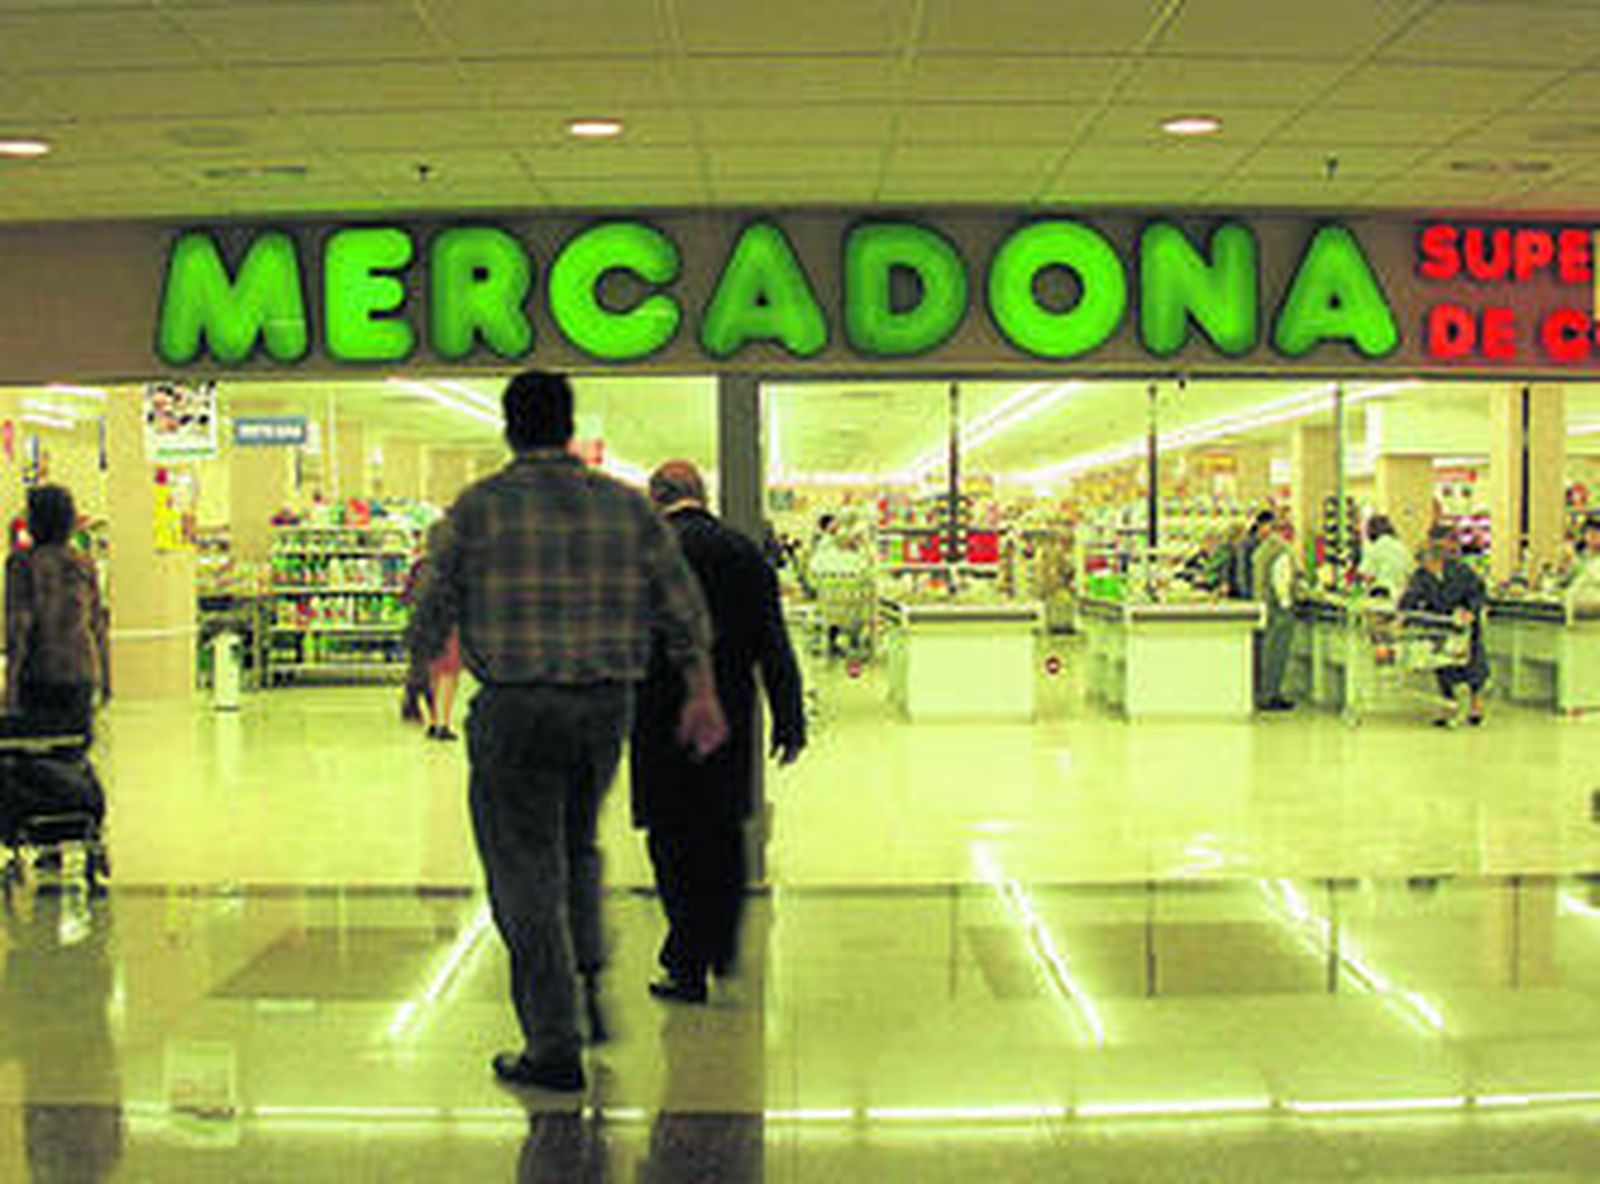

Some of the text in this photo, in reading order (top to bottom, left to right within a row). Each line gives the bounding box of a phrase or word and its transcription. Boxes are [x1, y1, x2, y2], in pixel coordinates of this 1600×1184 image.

[156, 220, 1399, 362] MERCADONA
[1428, 303, 1600, 362] DE C
